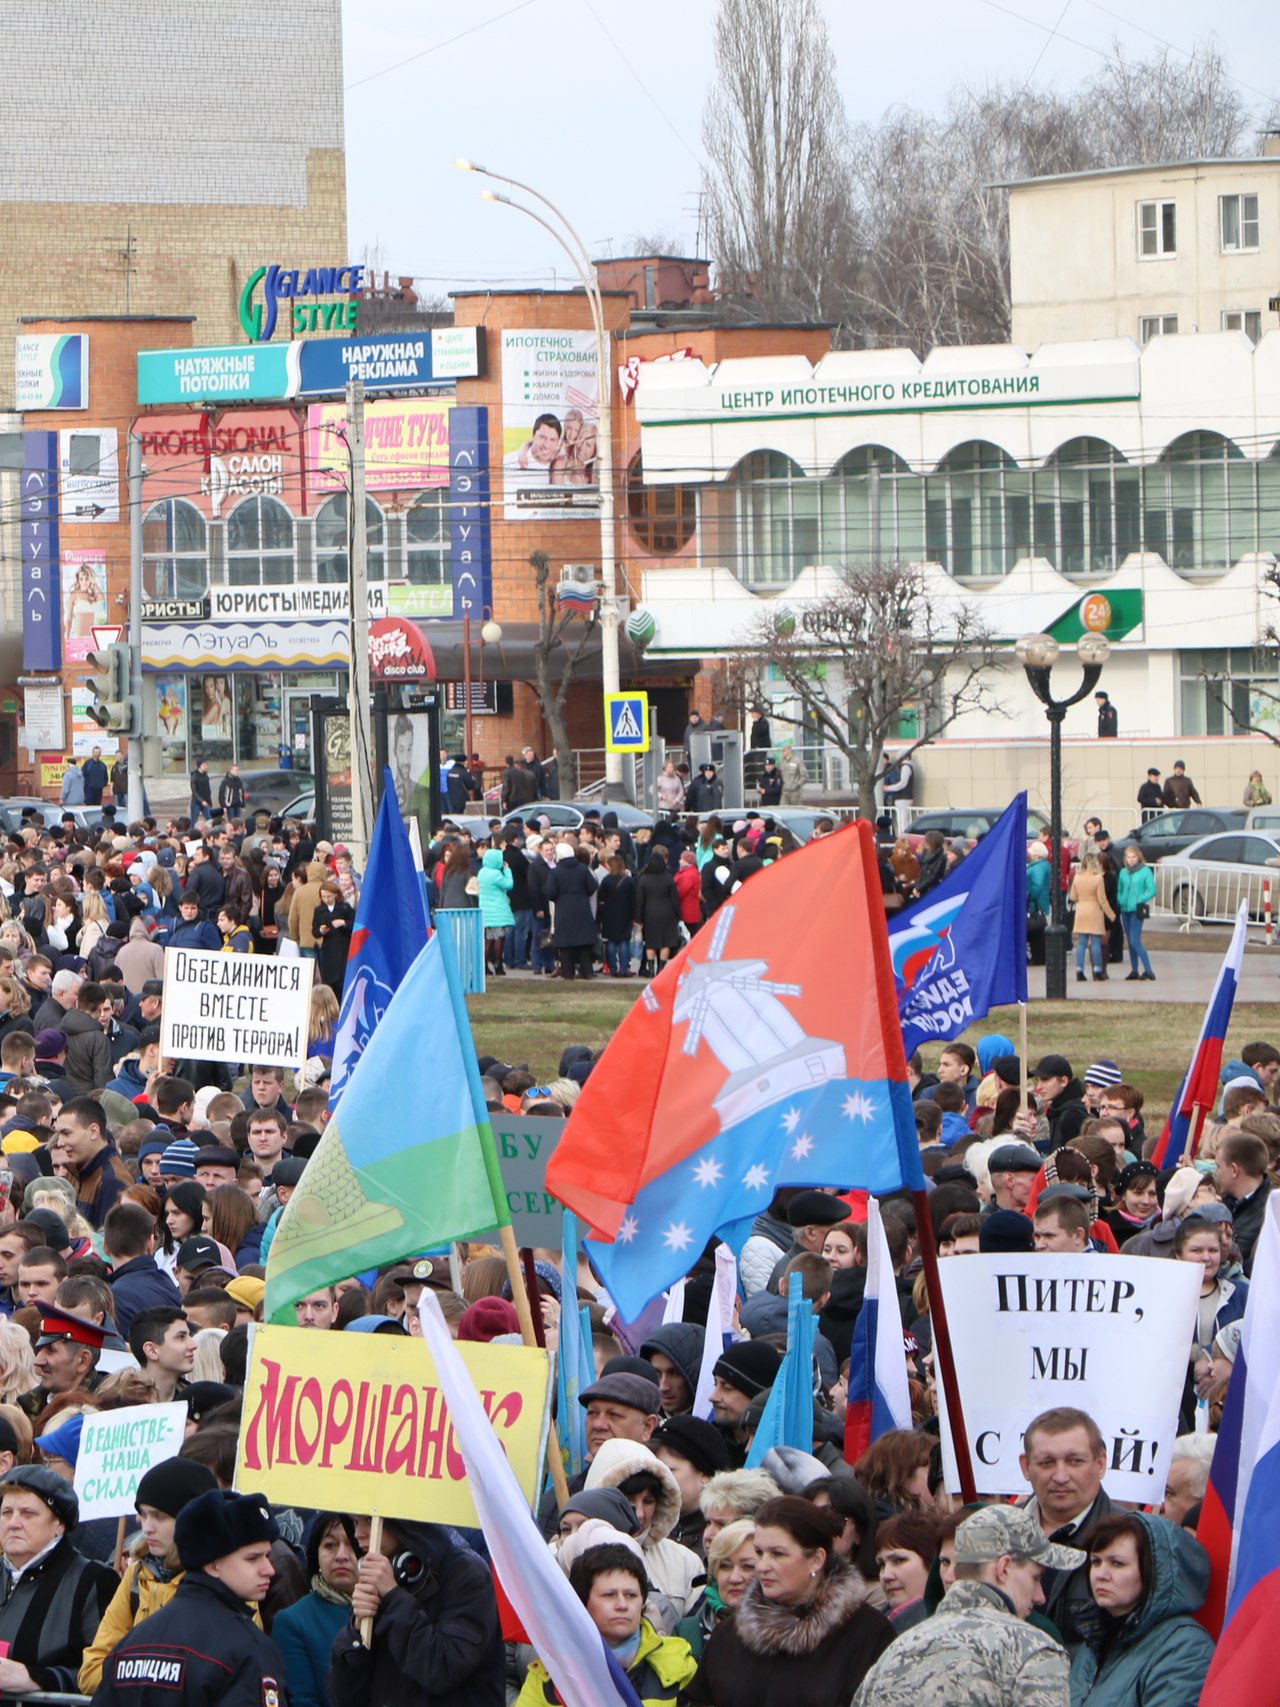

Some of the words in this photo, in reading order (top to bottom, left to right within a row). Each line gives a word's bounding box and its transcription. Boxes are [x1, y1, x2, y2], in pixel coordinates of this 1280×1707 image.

[274, 265, 365, 298] GLANCE
[292, 301, 361, 334] STYLE
[342, 342, 424, 365] НАРУЖНАЯ
[506, 337, 574, 348] ИПОТЕЧНОЕ
[175, 355, 255, 376] НАТЯЖНЫЕ
[350, 359, 418, 380] РЕКЛАМА
[180, 372, 250, 393] ПОТОЛКИ
[721, 391, 774, 410] ЦЕНТР
[781, 383, 895, 406] ИПОТЕЧНОГО
[901, 376, 1040, 399] КРЕДИТОВАНИЯ
[229, 455, 282, 474] САЛОН
[216, 592, 296, 615] ЮРИСТЫ
[384, 664, 406, 675] disco
[407, 663, 426, 675] club
[200, 992, 269, 1022] ВМЕСТЕ
[171, 1023, 225, 1052] ПРОТИВ
[233, 1026, 300, 1058] ТЕРРОРА!
[993, 1272, 1144, 1322] ПИТЕР,
[1030, 1346, 1090, 1382] МЫ
[102, 1448, 151, 1474] НАША
[976, 1431, 1001, 1466] С
[83, 1474, 138, 1502] СИЛА
[116, 1659, 182, 1683] ПОЛИЦИЯ
